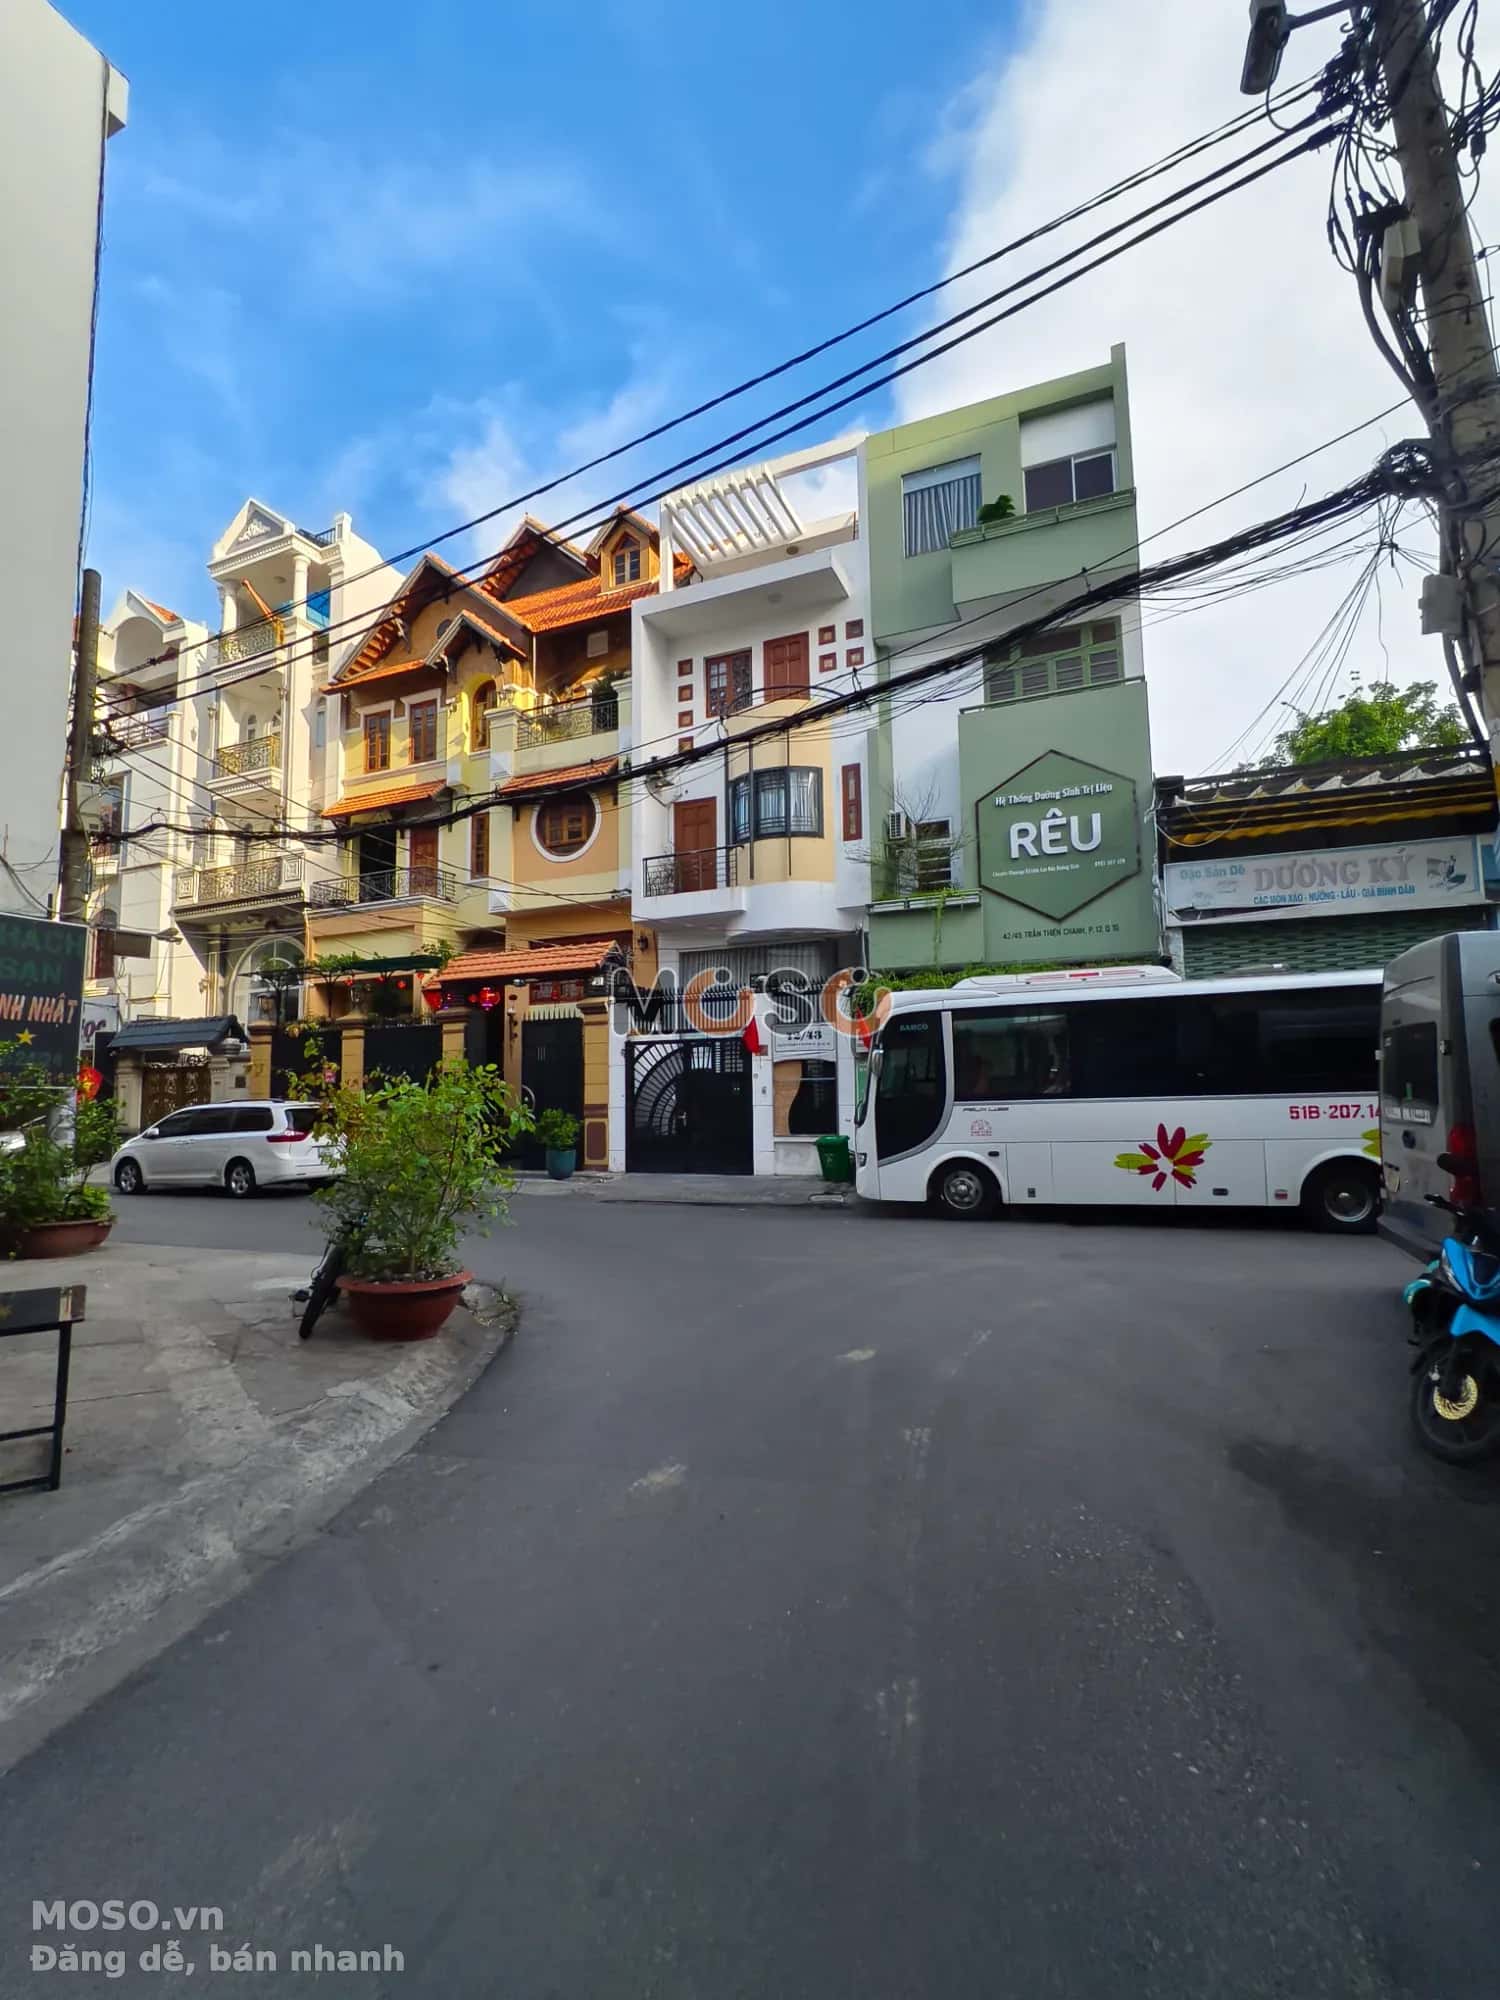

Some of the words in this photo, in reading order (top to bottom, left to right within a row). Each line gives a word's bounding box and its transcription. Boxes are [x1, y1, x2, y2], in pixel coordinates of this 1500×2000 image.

[1009, 807, 1102, 859] RÊU
[1253, 857, 1361, 892] DƯƠNG
[28, 992, 79, 1029] NHẬT
